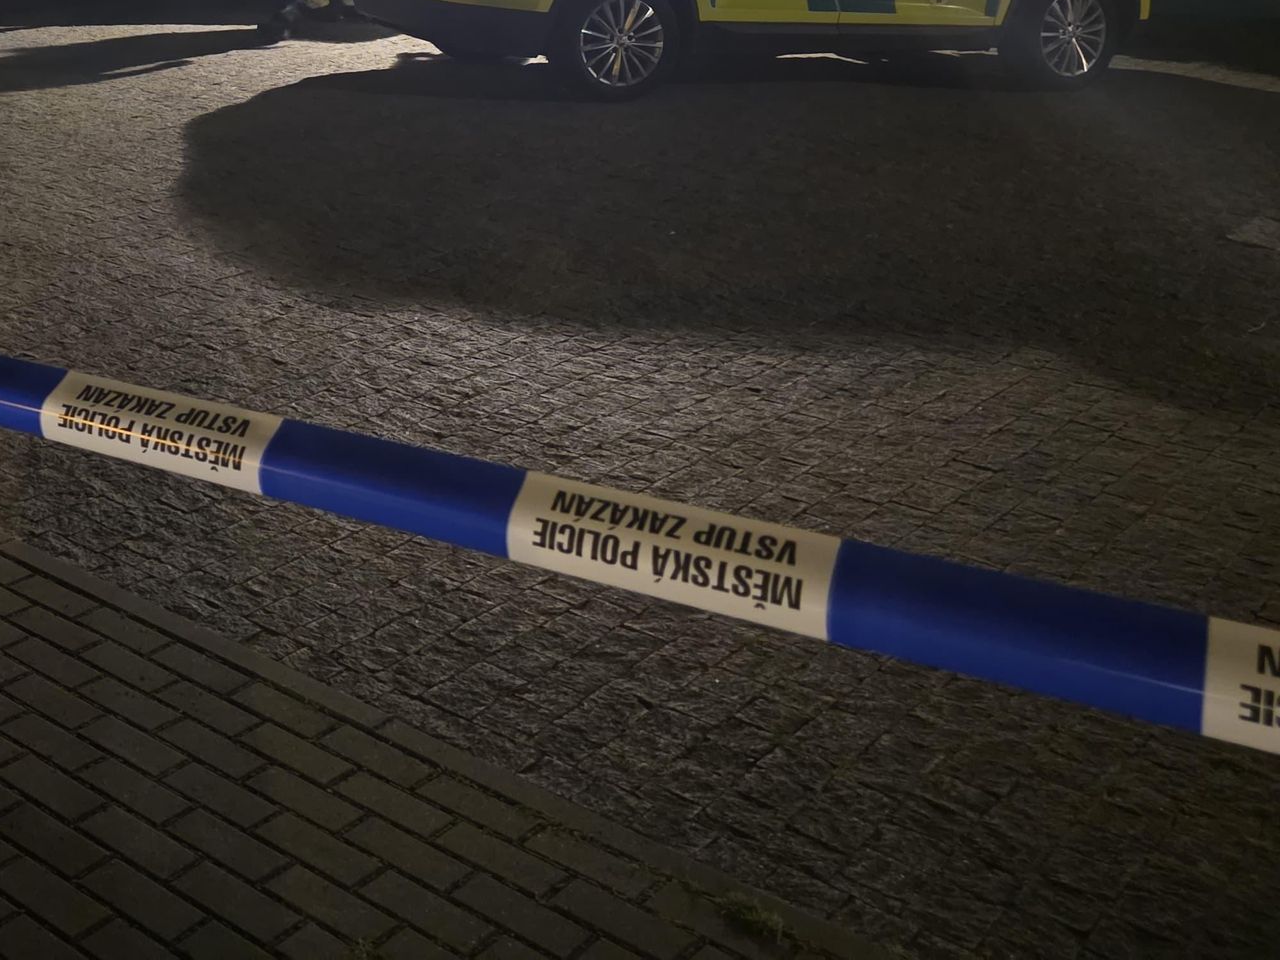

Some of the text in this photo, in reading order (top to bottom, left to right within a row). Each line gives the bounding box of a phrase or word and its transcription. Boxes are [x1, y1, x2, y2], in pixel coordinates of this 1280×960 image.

[57, 403, 246, 472] MĚSTSKÁ POLICIE
[76, 384, 251, 437] VSTUP ZAKÁZÁN
[532, 517, 804, 611] MĚSTSKÁ POLICIE
[550, 489, 797, 566] VSTUP ZAKÁZÁN
